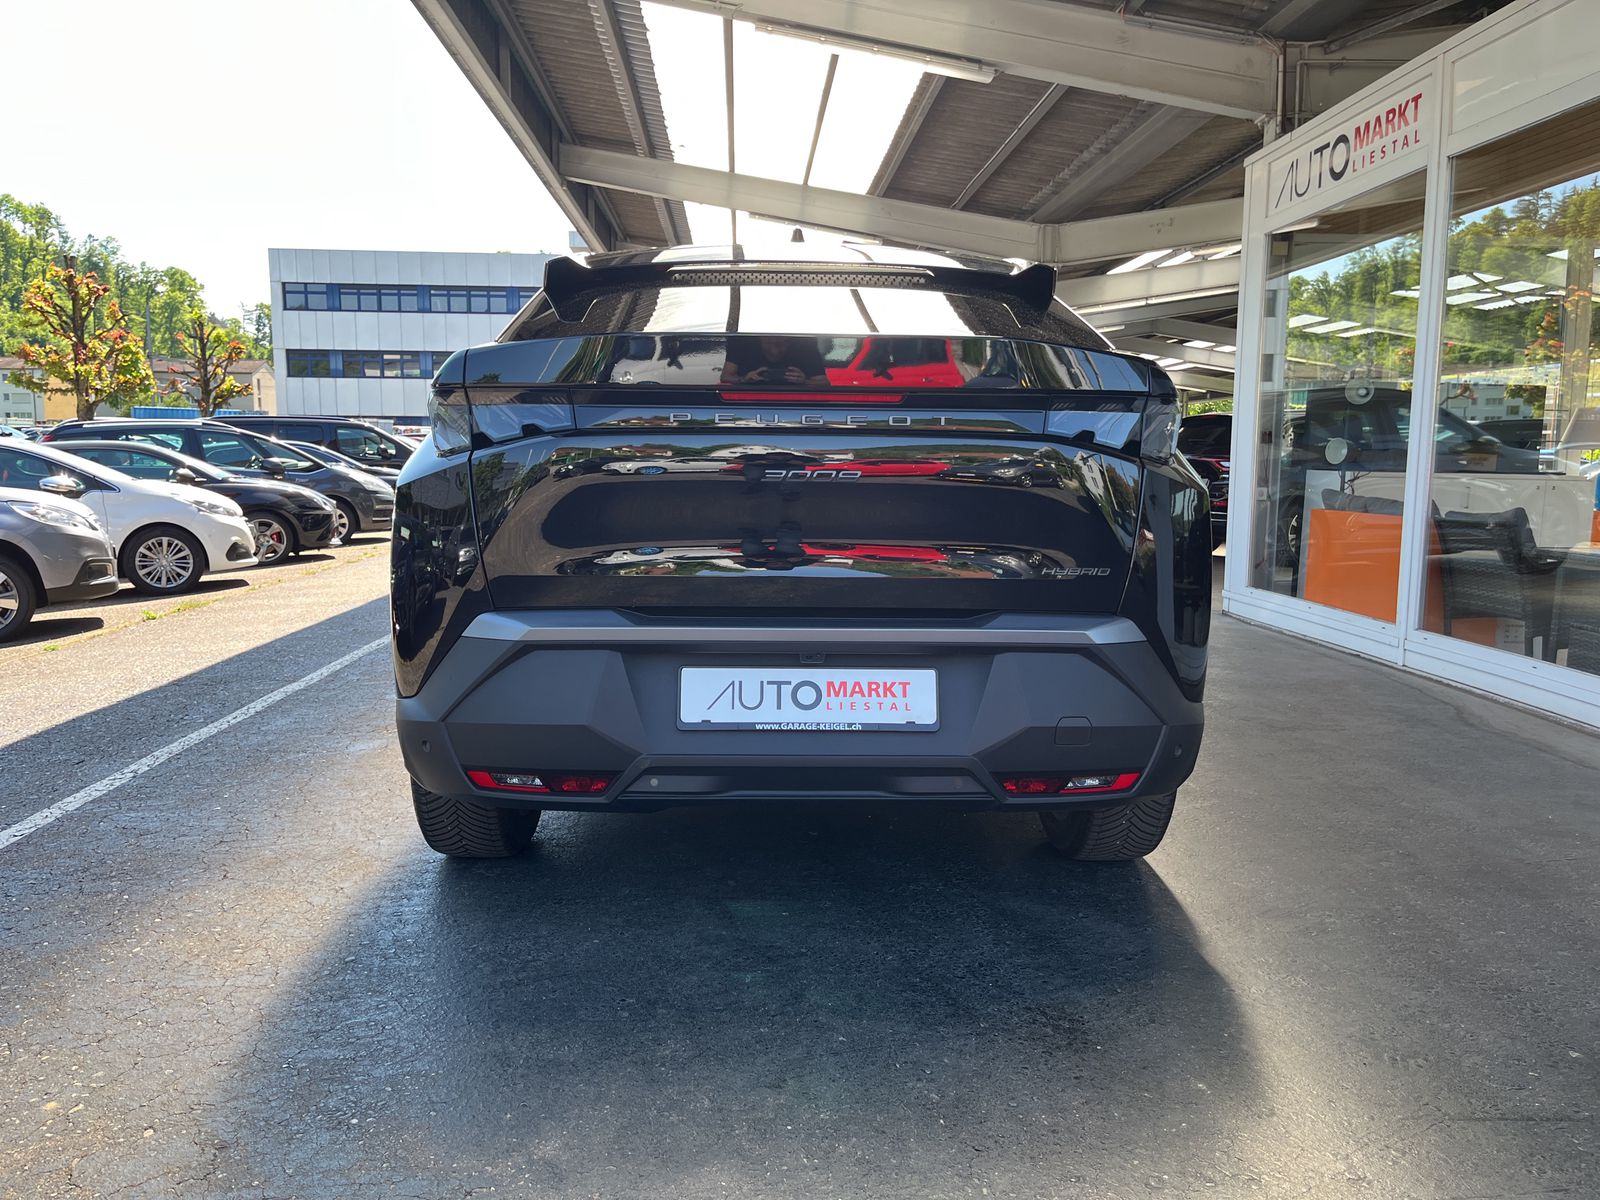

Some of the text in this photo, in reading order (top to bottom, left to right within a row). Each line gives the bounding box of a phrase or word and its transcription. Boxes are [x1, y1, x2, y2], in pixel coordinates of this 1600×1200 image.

[1275, 93, 1423, 209] AUTO MARKT
[1352, 129, 1421, 173] LIESTAL
[669, 412, 953, 426] PEUGEOT
[1041, 567, 1111, 576] HYBRID
[707, 680, 911, 711] AUTO MARKT
[826, 702, 911, 712] LIESTAL
[755, 722, 862, 731] www.GARAGE-KEIGEL.ch
